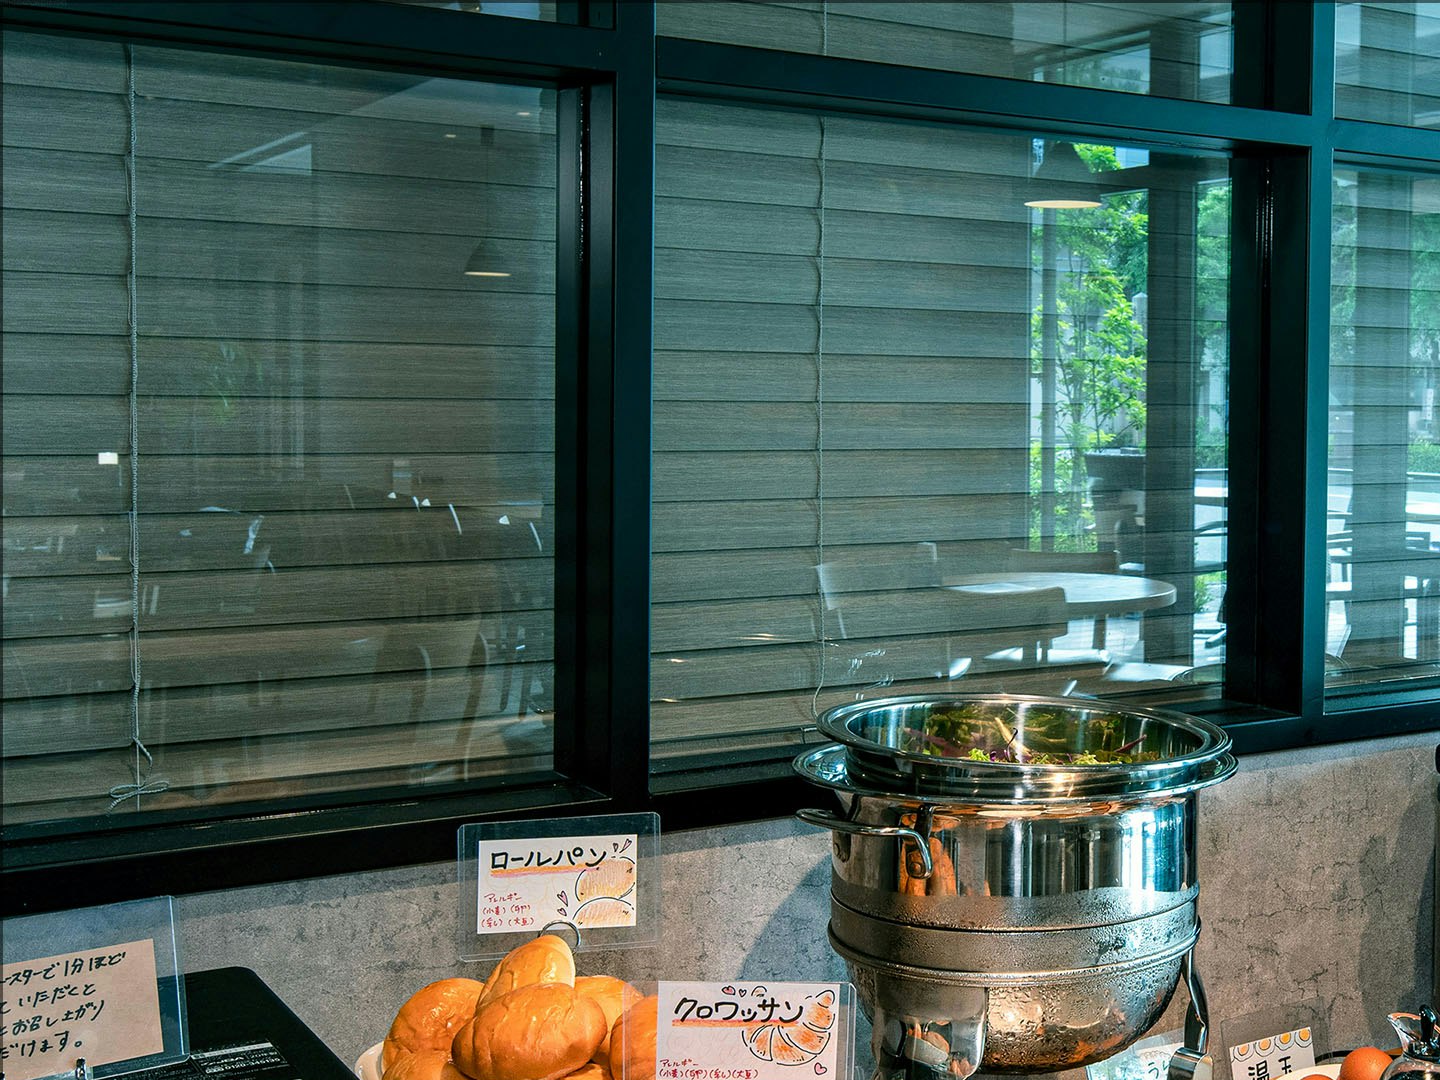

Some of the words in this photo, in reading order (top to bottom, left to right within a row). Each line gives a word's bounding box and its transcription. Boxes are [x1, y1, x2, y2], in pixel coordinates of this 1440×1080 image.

[491, 847, 607, 870] ロールパン
[674, 997, 803, 1022] クロワッサン
